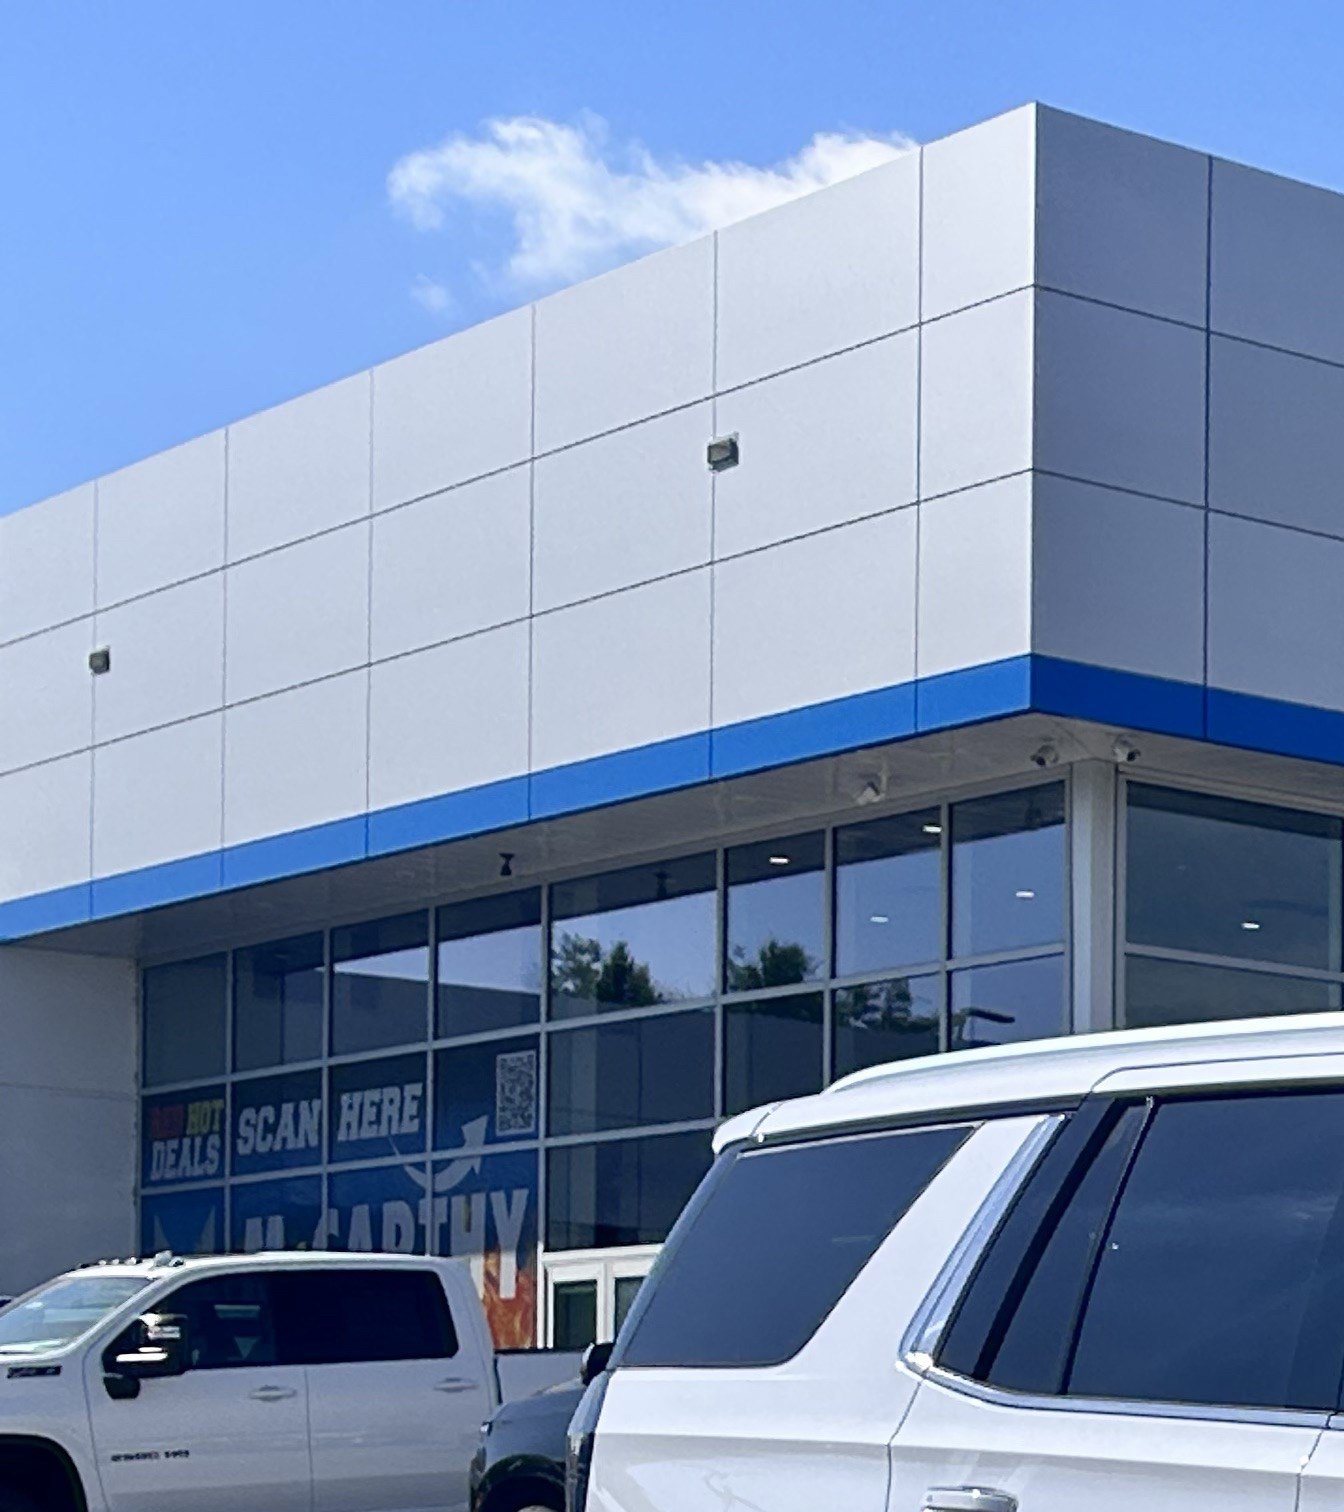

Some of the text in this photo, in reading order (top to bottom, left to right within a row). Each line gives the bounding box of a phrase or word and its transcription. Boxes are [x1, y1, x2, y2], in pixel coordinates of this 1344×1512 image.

[236, 1083, 423, 1156] SCAN HERE
[150, 1134, 222, 1181] DEALS
